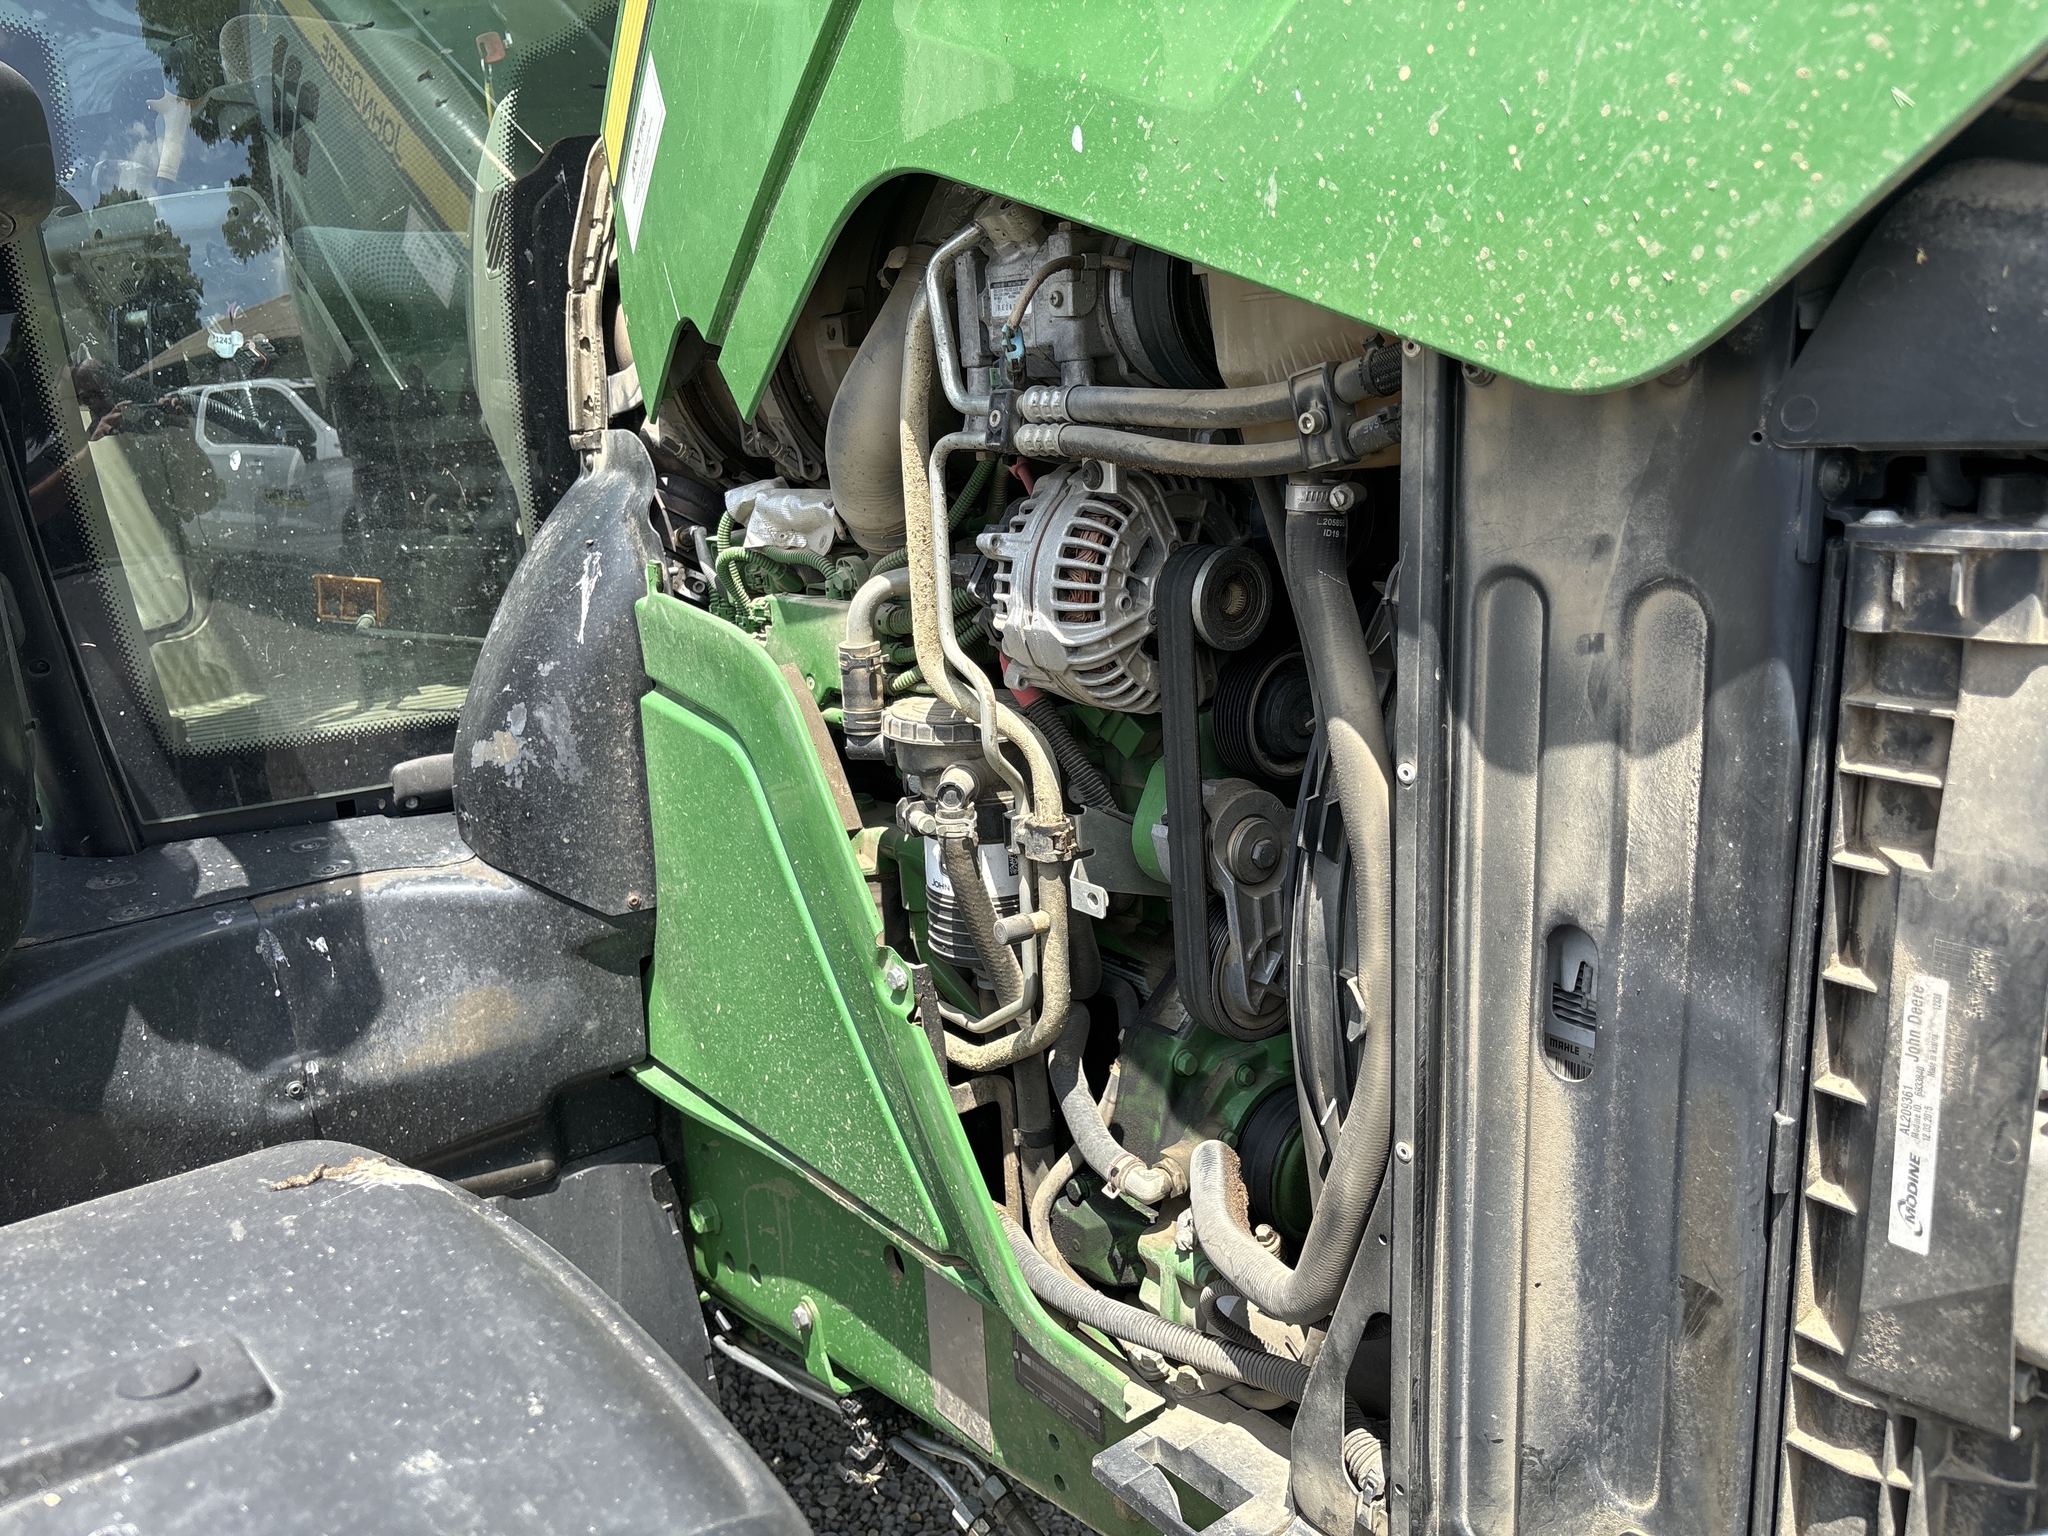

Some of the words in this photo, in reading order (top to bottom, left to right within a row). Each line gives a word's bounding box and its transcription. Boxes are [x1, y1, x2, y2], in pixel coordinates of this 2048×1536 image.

[215, 336, 232, 345] 1243
[1322, 529, 1340, 538] ID19
[931, 877, 951, 891] JOHN
[1907, 985, 1925, 1026] Deere
[1549, 1038, 1580, 1057] MAHLE
[1905, 1029, 1922, 1063] John
[1899, 1085, 1914, 1136] AL209361
[1922, 1105, 1934, 1142] 12.03.2015
[1910, 1114, 1921, 1140] Modine
[1904, 1152, 1921, 1225] MODINE
